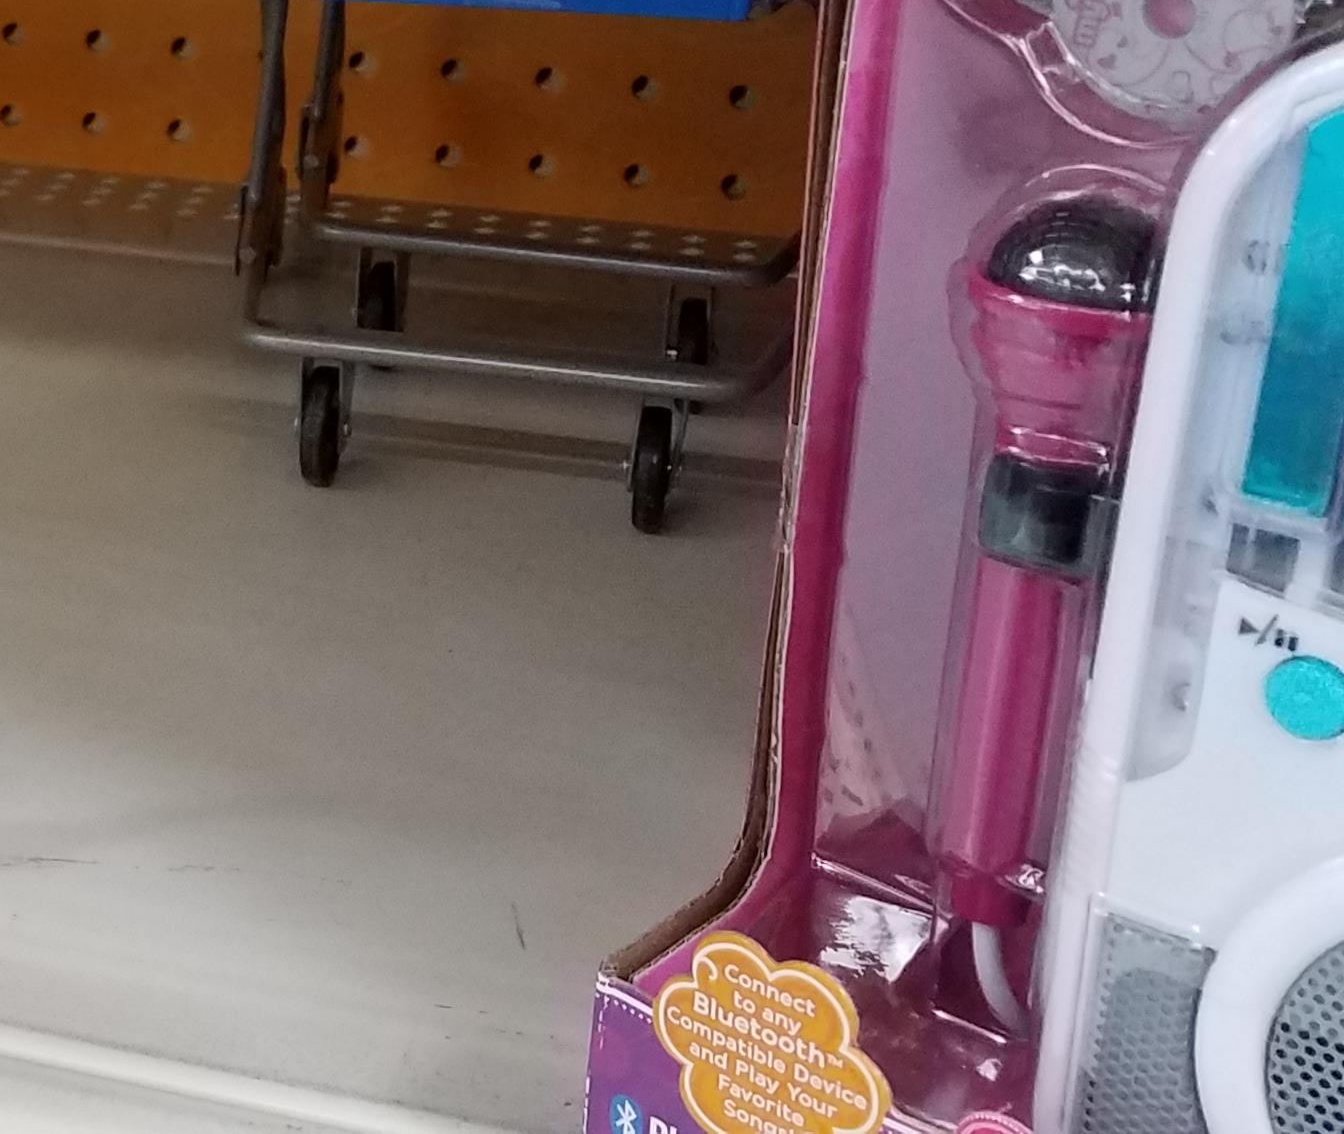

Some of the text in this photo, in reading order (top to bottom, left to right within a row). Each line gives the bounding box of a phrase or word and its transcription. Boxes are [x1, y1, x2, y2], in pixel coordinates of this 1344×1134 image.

[724, 964, 816, 1018] Connect
[733, 990, 802, 1036] to any
[666, 1006, 868, 1111] Compatible Device
[689, 1041, 839, 1119] and Play Your
[718, 1074, 805, 1128] Favorite
